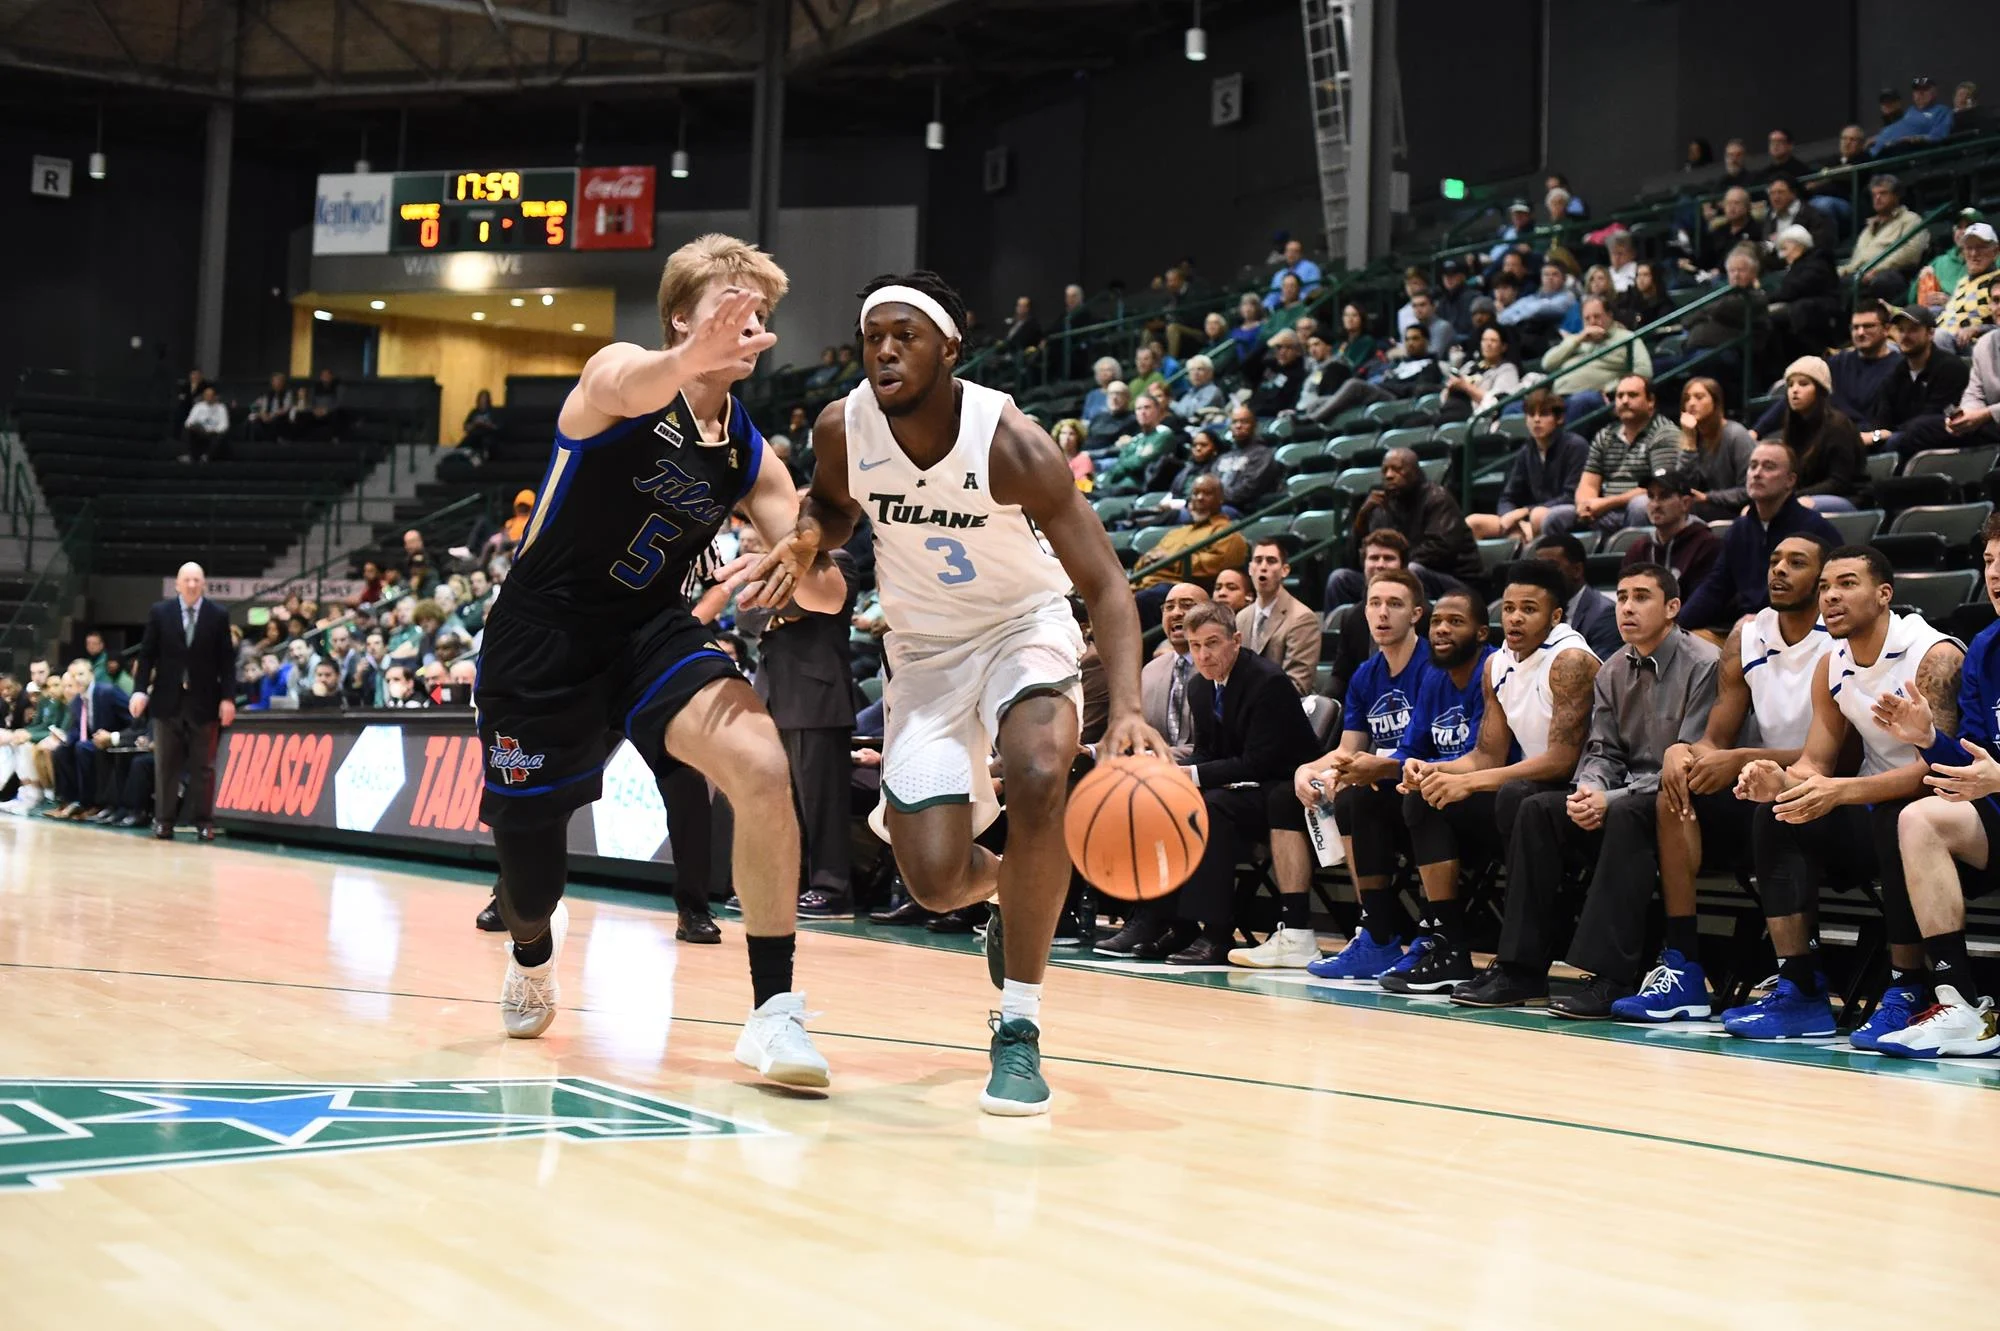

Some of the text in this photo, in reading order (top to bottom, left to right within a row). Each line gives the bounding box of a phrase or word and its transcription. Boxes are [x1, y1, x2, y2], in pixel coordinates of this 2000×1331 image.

[44, 169, 60, 192] R
[456, 171, 520, 201] 17:59
[419, 219, 439, 247] 0
[478, 221, 489, 243] 1
[545, 216, 564, 245] 5
[632, 458, 725, 525] Tulsa
[609, 513, 682, 590] 5
[924, 537, 977, 585] 3
[489, 745, 545, 770] Tulsa
[215, 733, 333, 817] TABASCO
